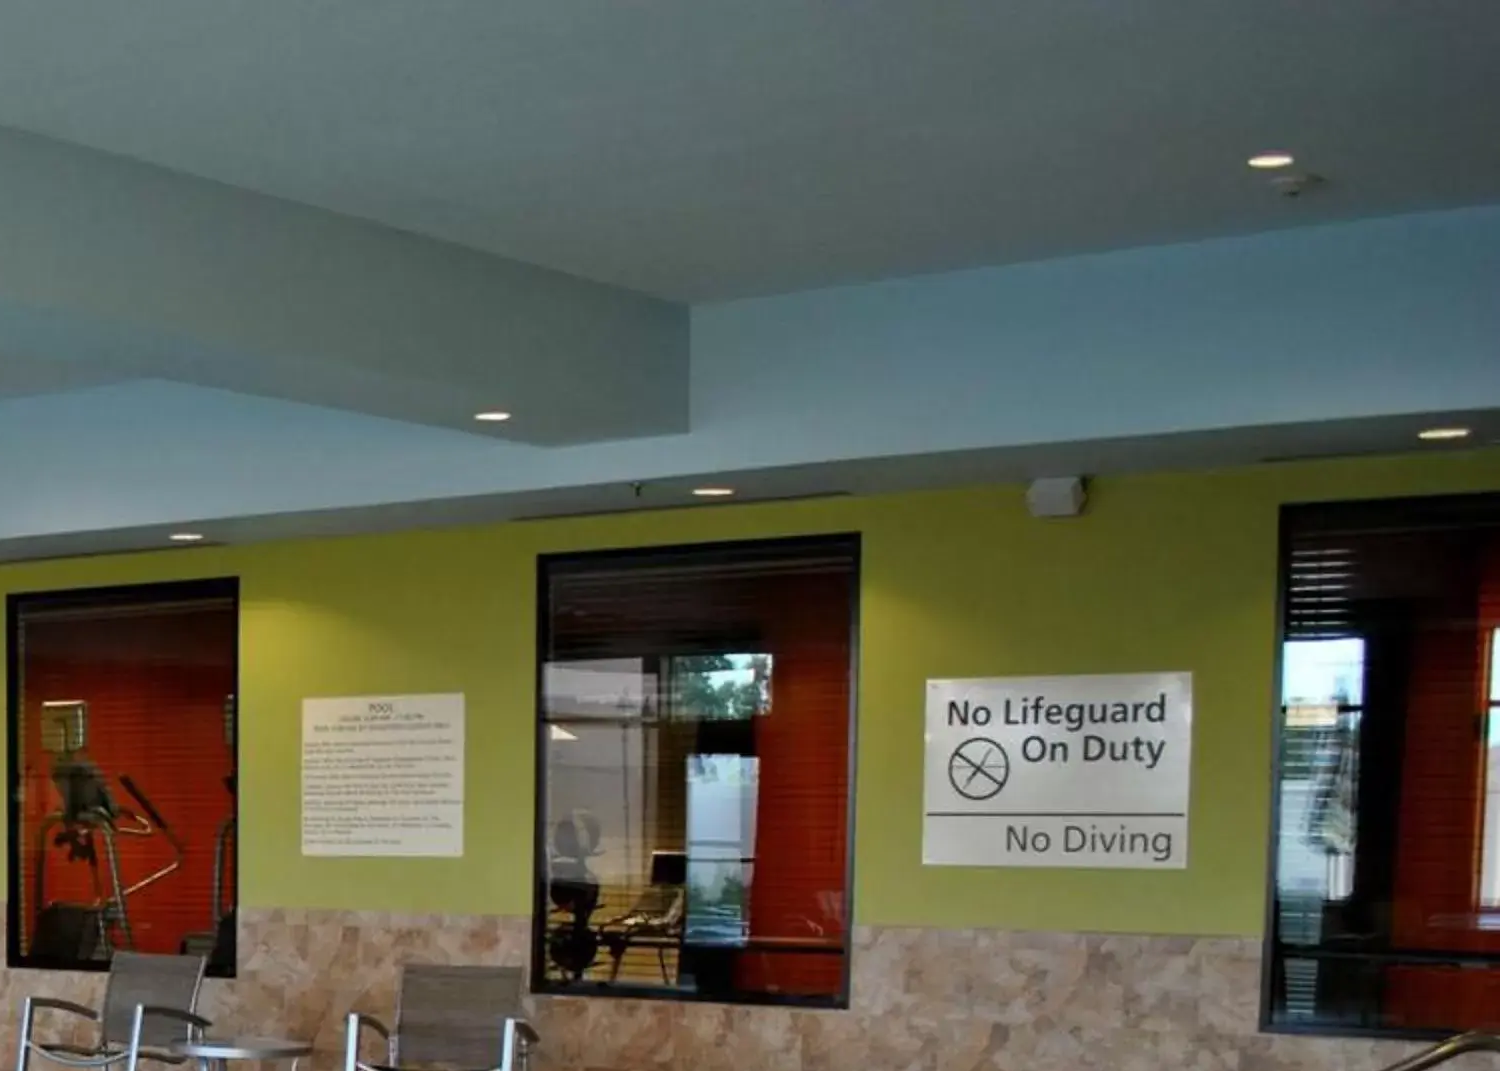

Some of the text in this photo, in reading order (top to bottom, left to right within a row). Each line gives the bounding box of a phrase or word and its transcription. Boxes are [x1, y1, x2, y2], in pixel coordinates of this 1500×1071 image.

[369, 703, 393, 713] POOL
[948, 693, 1166, 732] No Lifeguard
[1022, 735, 1165, 768] On Duty
[1006, 825, 1171, 861] No Diving
